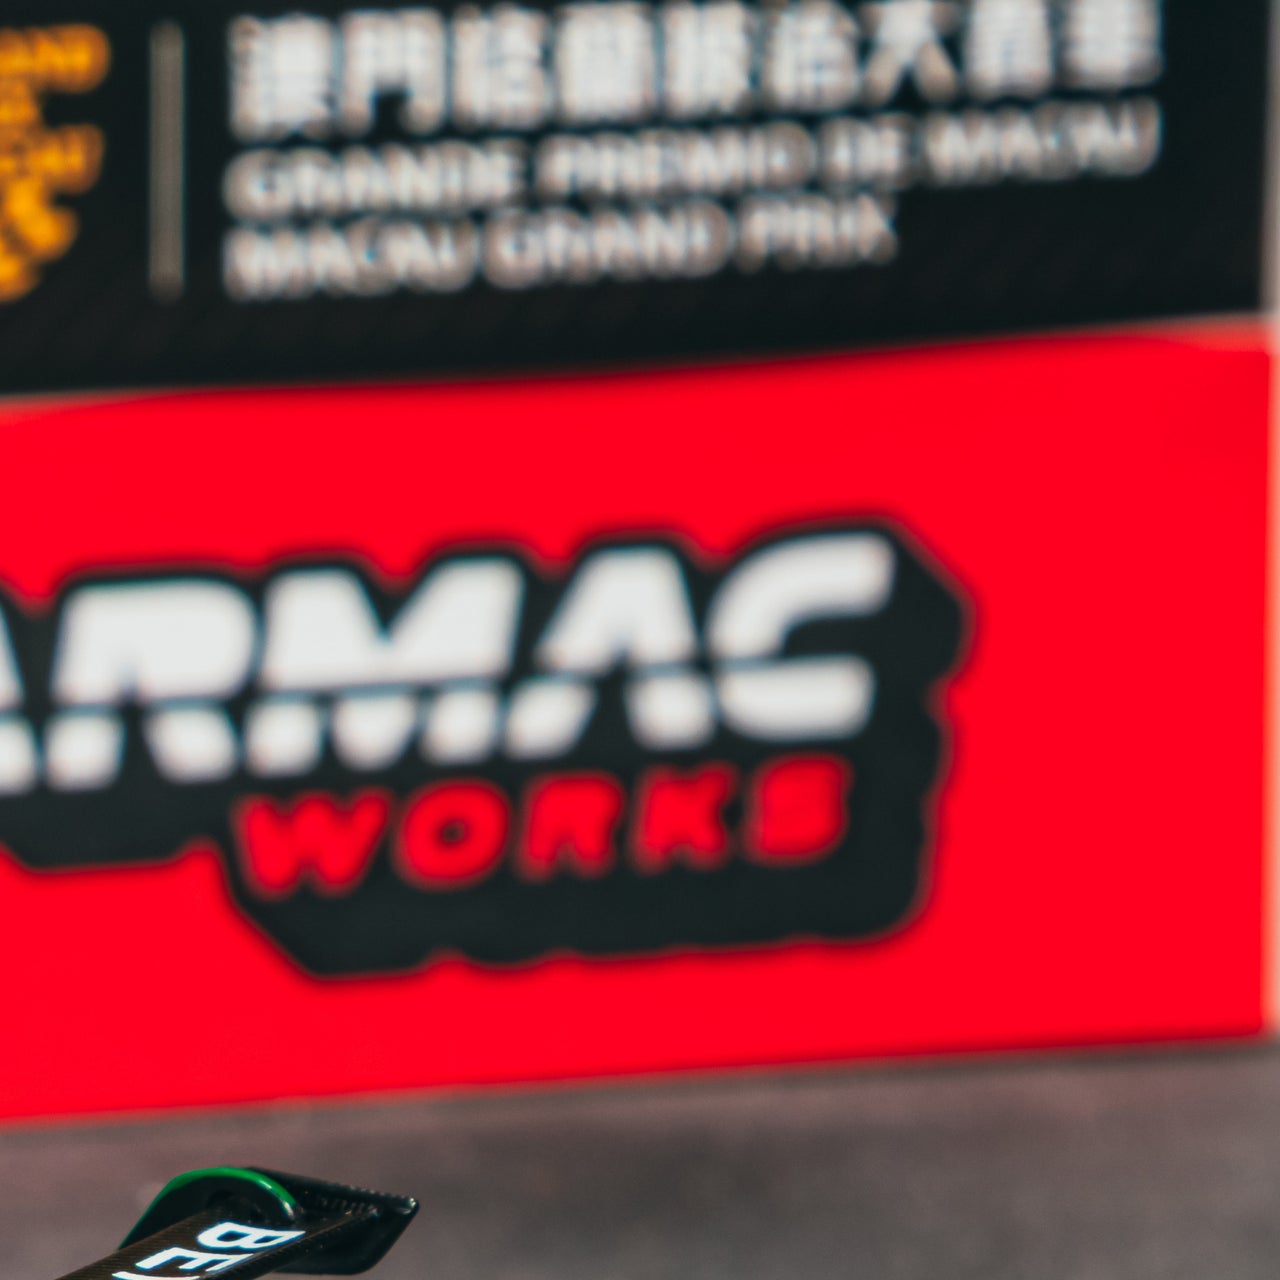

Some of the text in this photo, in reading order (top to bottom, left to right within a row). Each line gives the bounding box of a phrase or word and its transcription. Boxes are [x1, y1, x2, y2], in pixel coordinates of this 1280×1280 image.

[226, 145, 524, 219] GRANDE
[820, 112, 918, 192] DE
[926, 98, 1162, 187] MACAU
[224, 190, 900, 298] MACAU GRAND PRIX
[242, 758, 844, 894] WORKS
